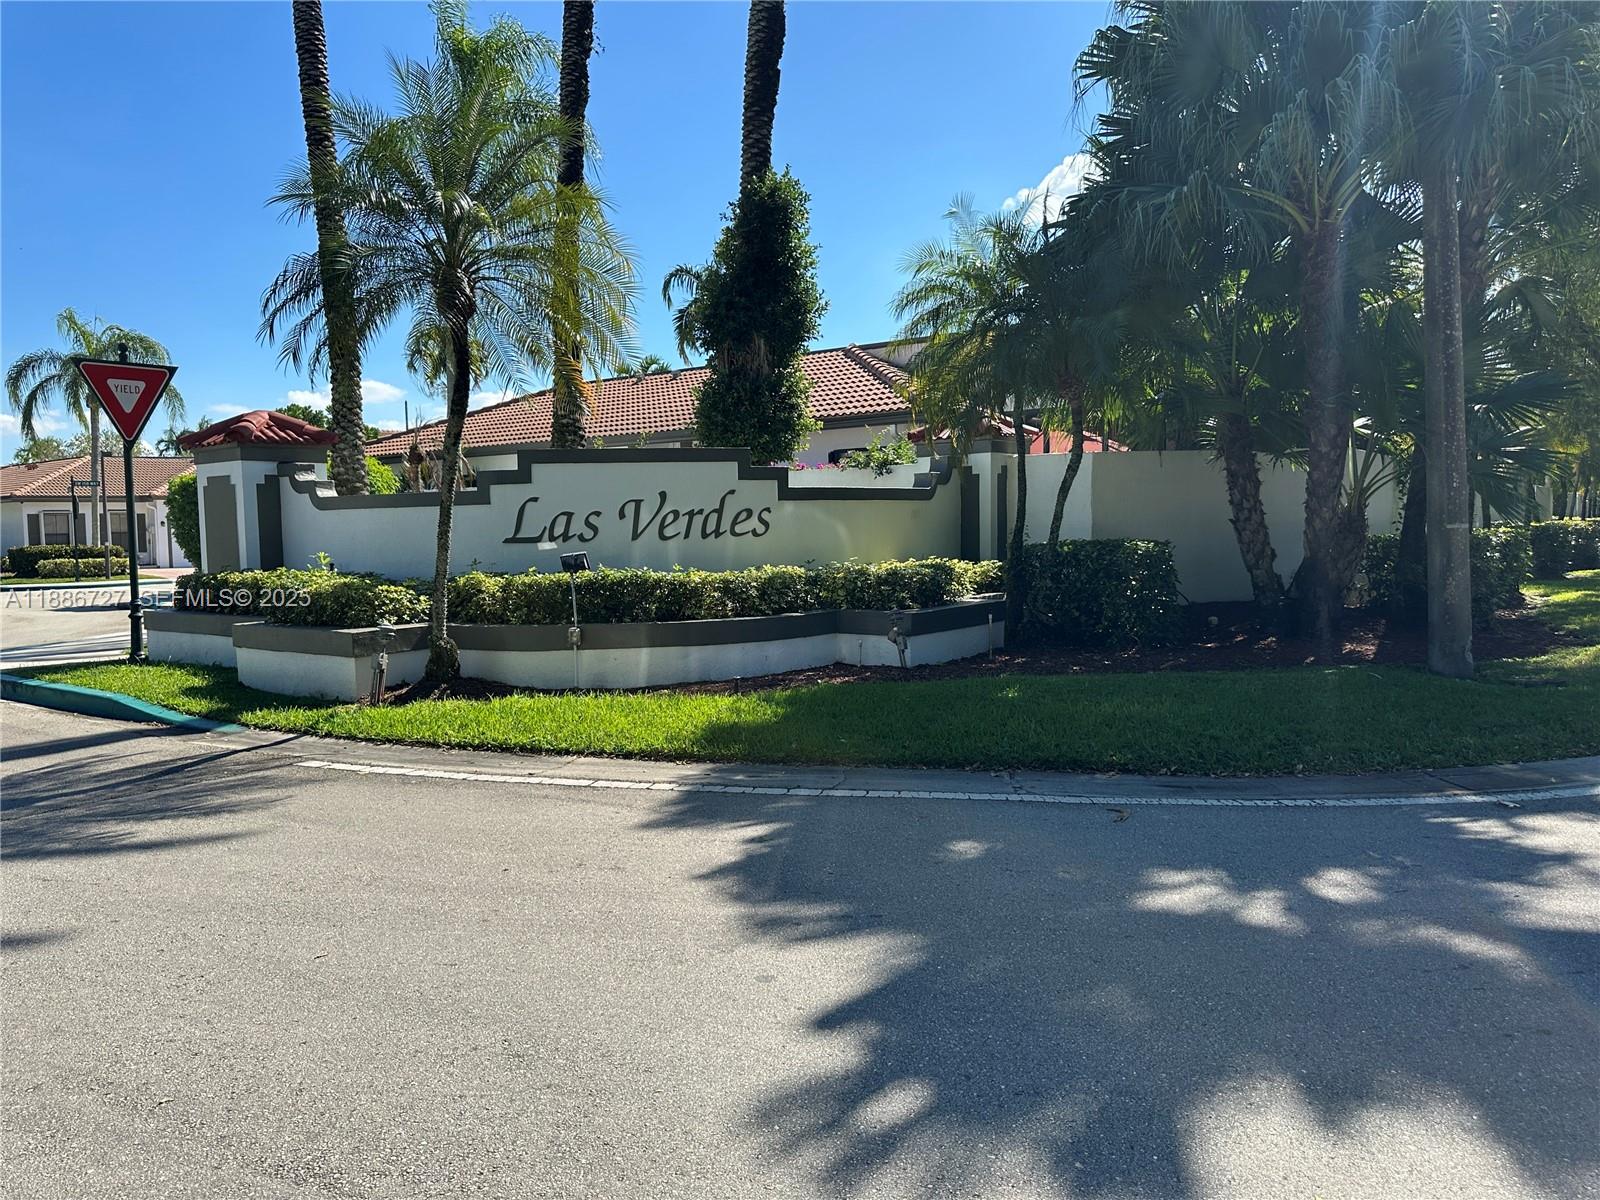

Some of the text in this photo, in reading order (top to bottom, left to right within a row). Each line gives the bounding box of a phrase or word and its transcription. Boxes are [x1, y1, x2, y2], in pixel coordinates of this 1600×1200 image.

[113, 383, 140, 394] YIELD
[502, 489, 772, 543] Las Verdes
